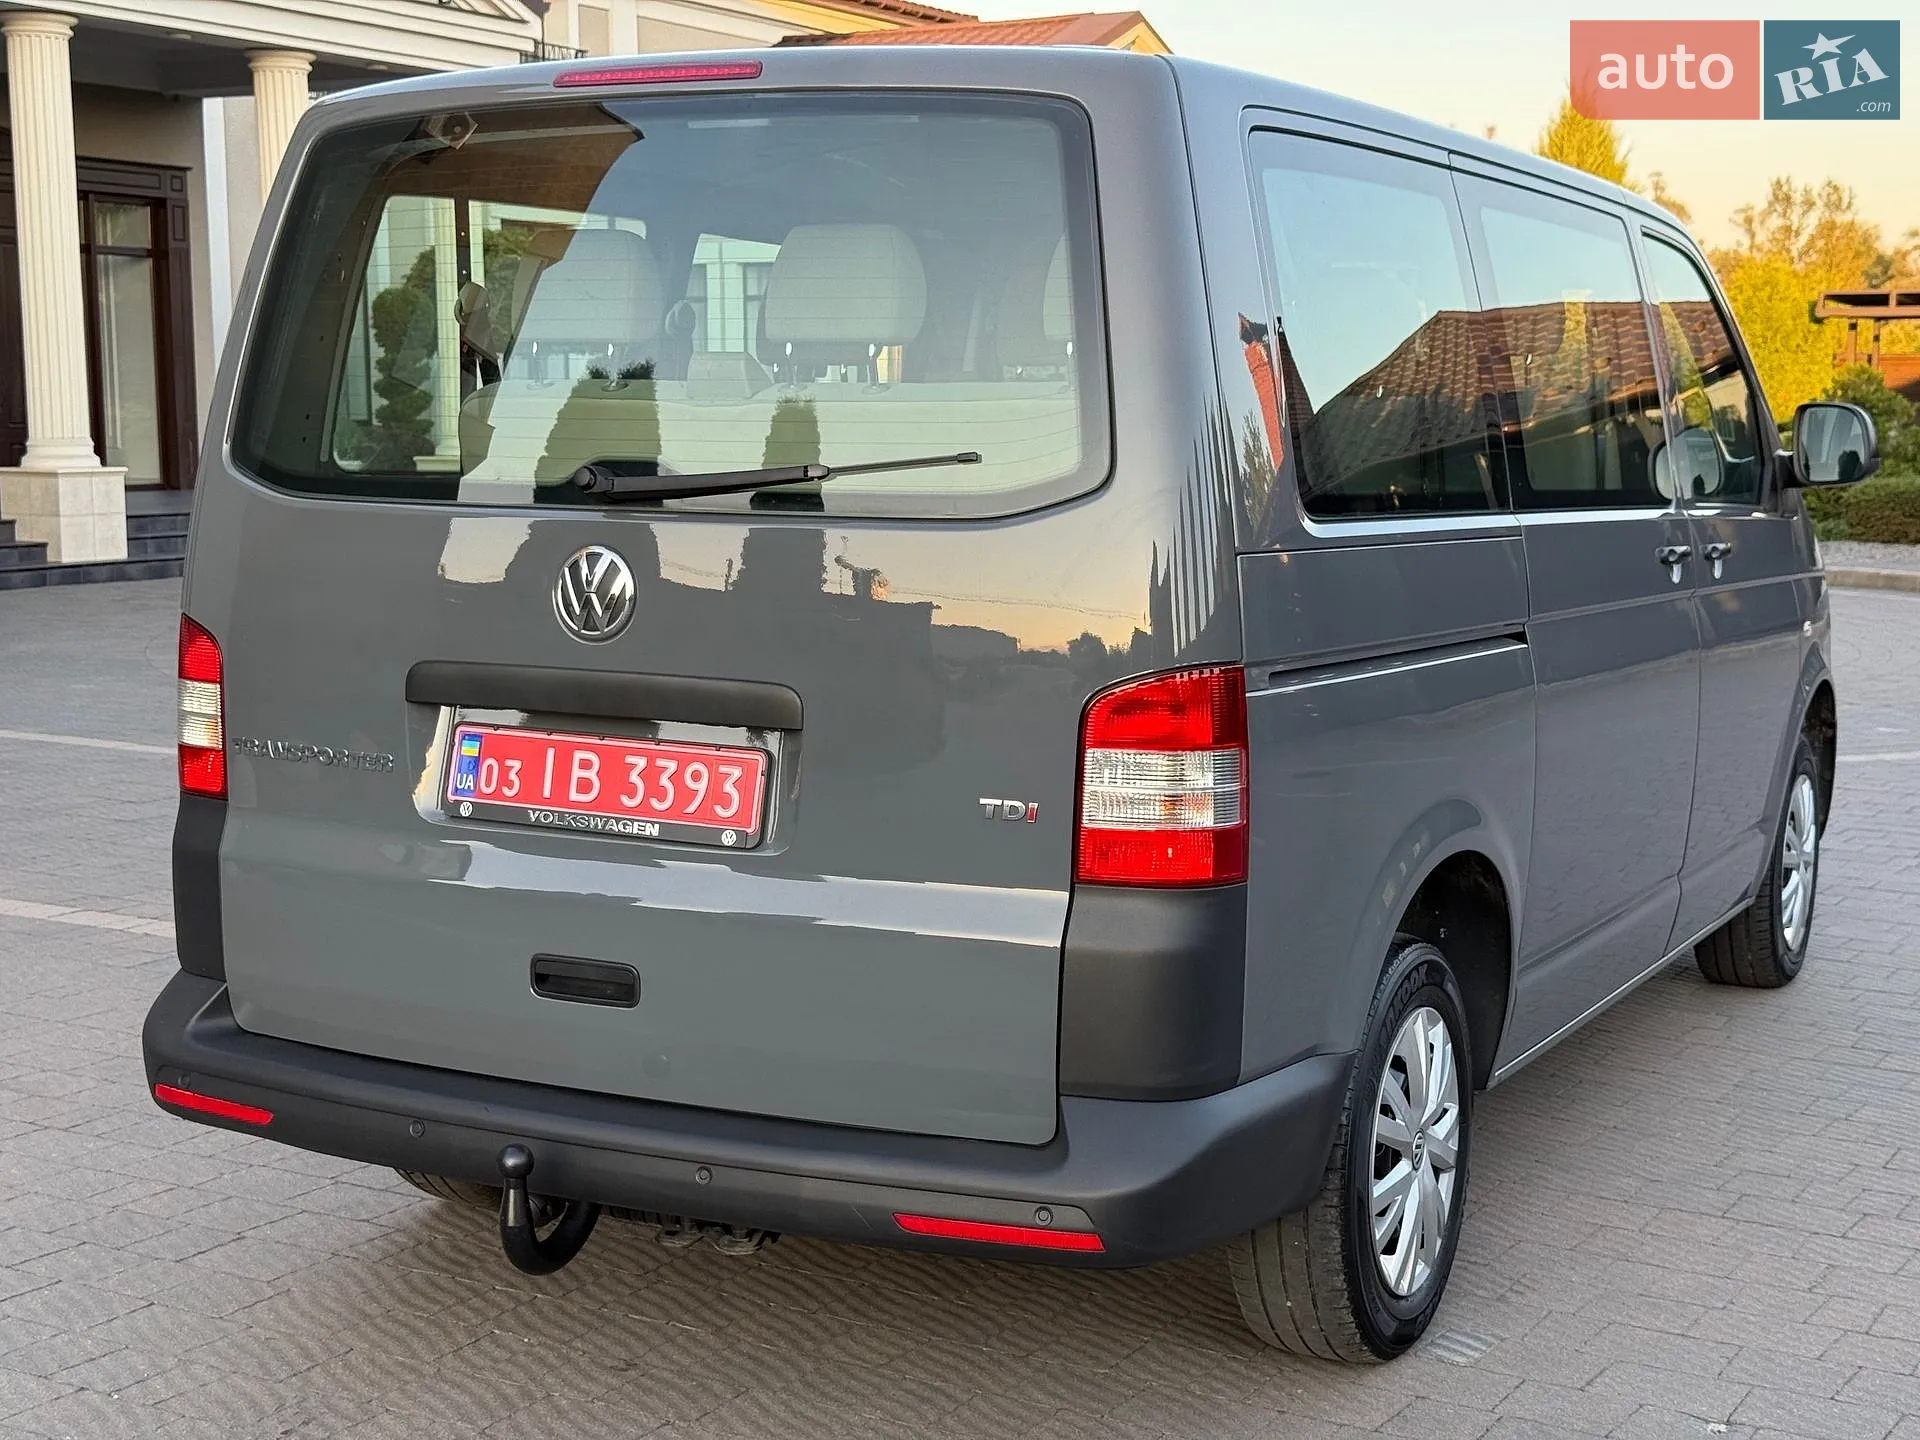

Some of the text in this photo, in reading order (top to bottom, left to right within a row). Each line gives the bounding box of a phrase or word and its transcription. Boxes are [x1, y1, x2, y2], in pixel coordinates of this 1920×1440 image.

[232, 737, 395, 773] TRANSPORTER
[456, 773, 474, 790] UA
[479, 747, 744, 818] 03 IB 3393
[527, 809, 660, 836] VOLKSWAGEN
[979, 798, 1038, 823] TDI
